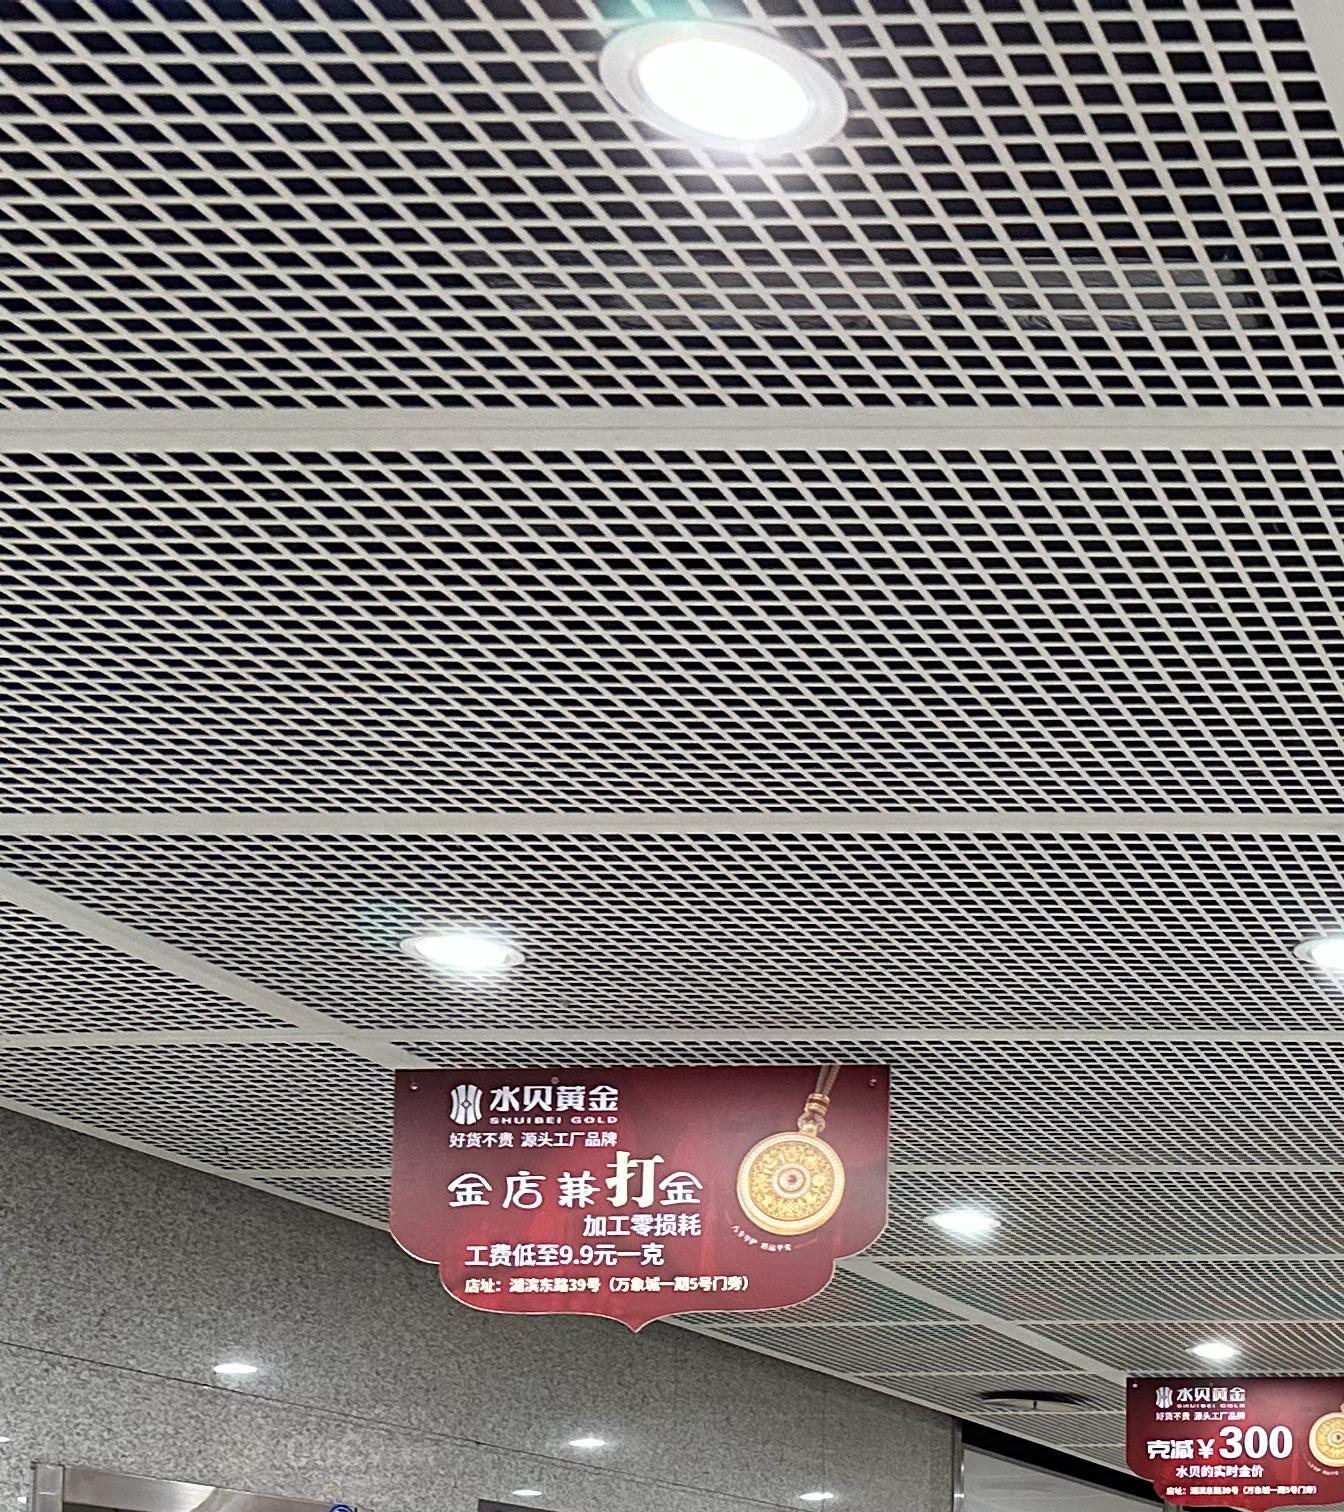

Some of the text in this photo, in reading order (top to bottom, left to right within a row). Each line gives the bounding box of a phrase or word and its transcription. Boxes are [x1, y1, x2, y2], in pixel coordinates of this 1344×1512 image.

[489, 1085, 619, 1112] 水贝黄金
[489, 1116, 618, 1125] SHUIBEI GOLD
[449, 1131, 618, 1148] 好货不贵 源头工厂品牌
[582, 1213, 702, 1237] 加工零损耗
[464, 1242, 665, 1267] 工费低至9.9元一克
